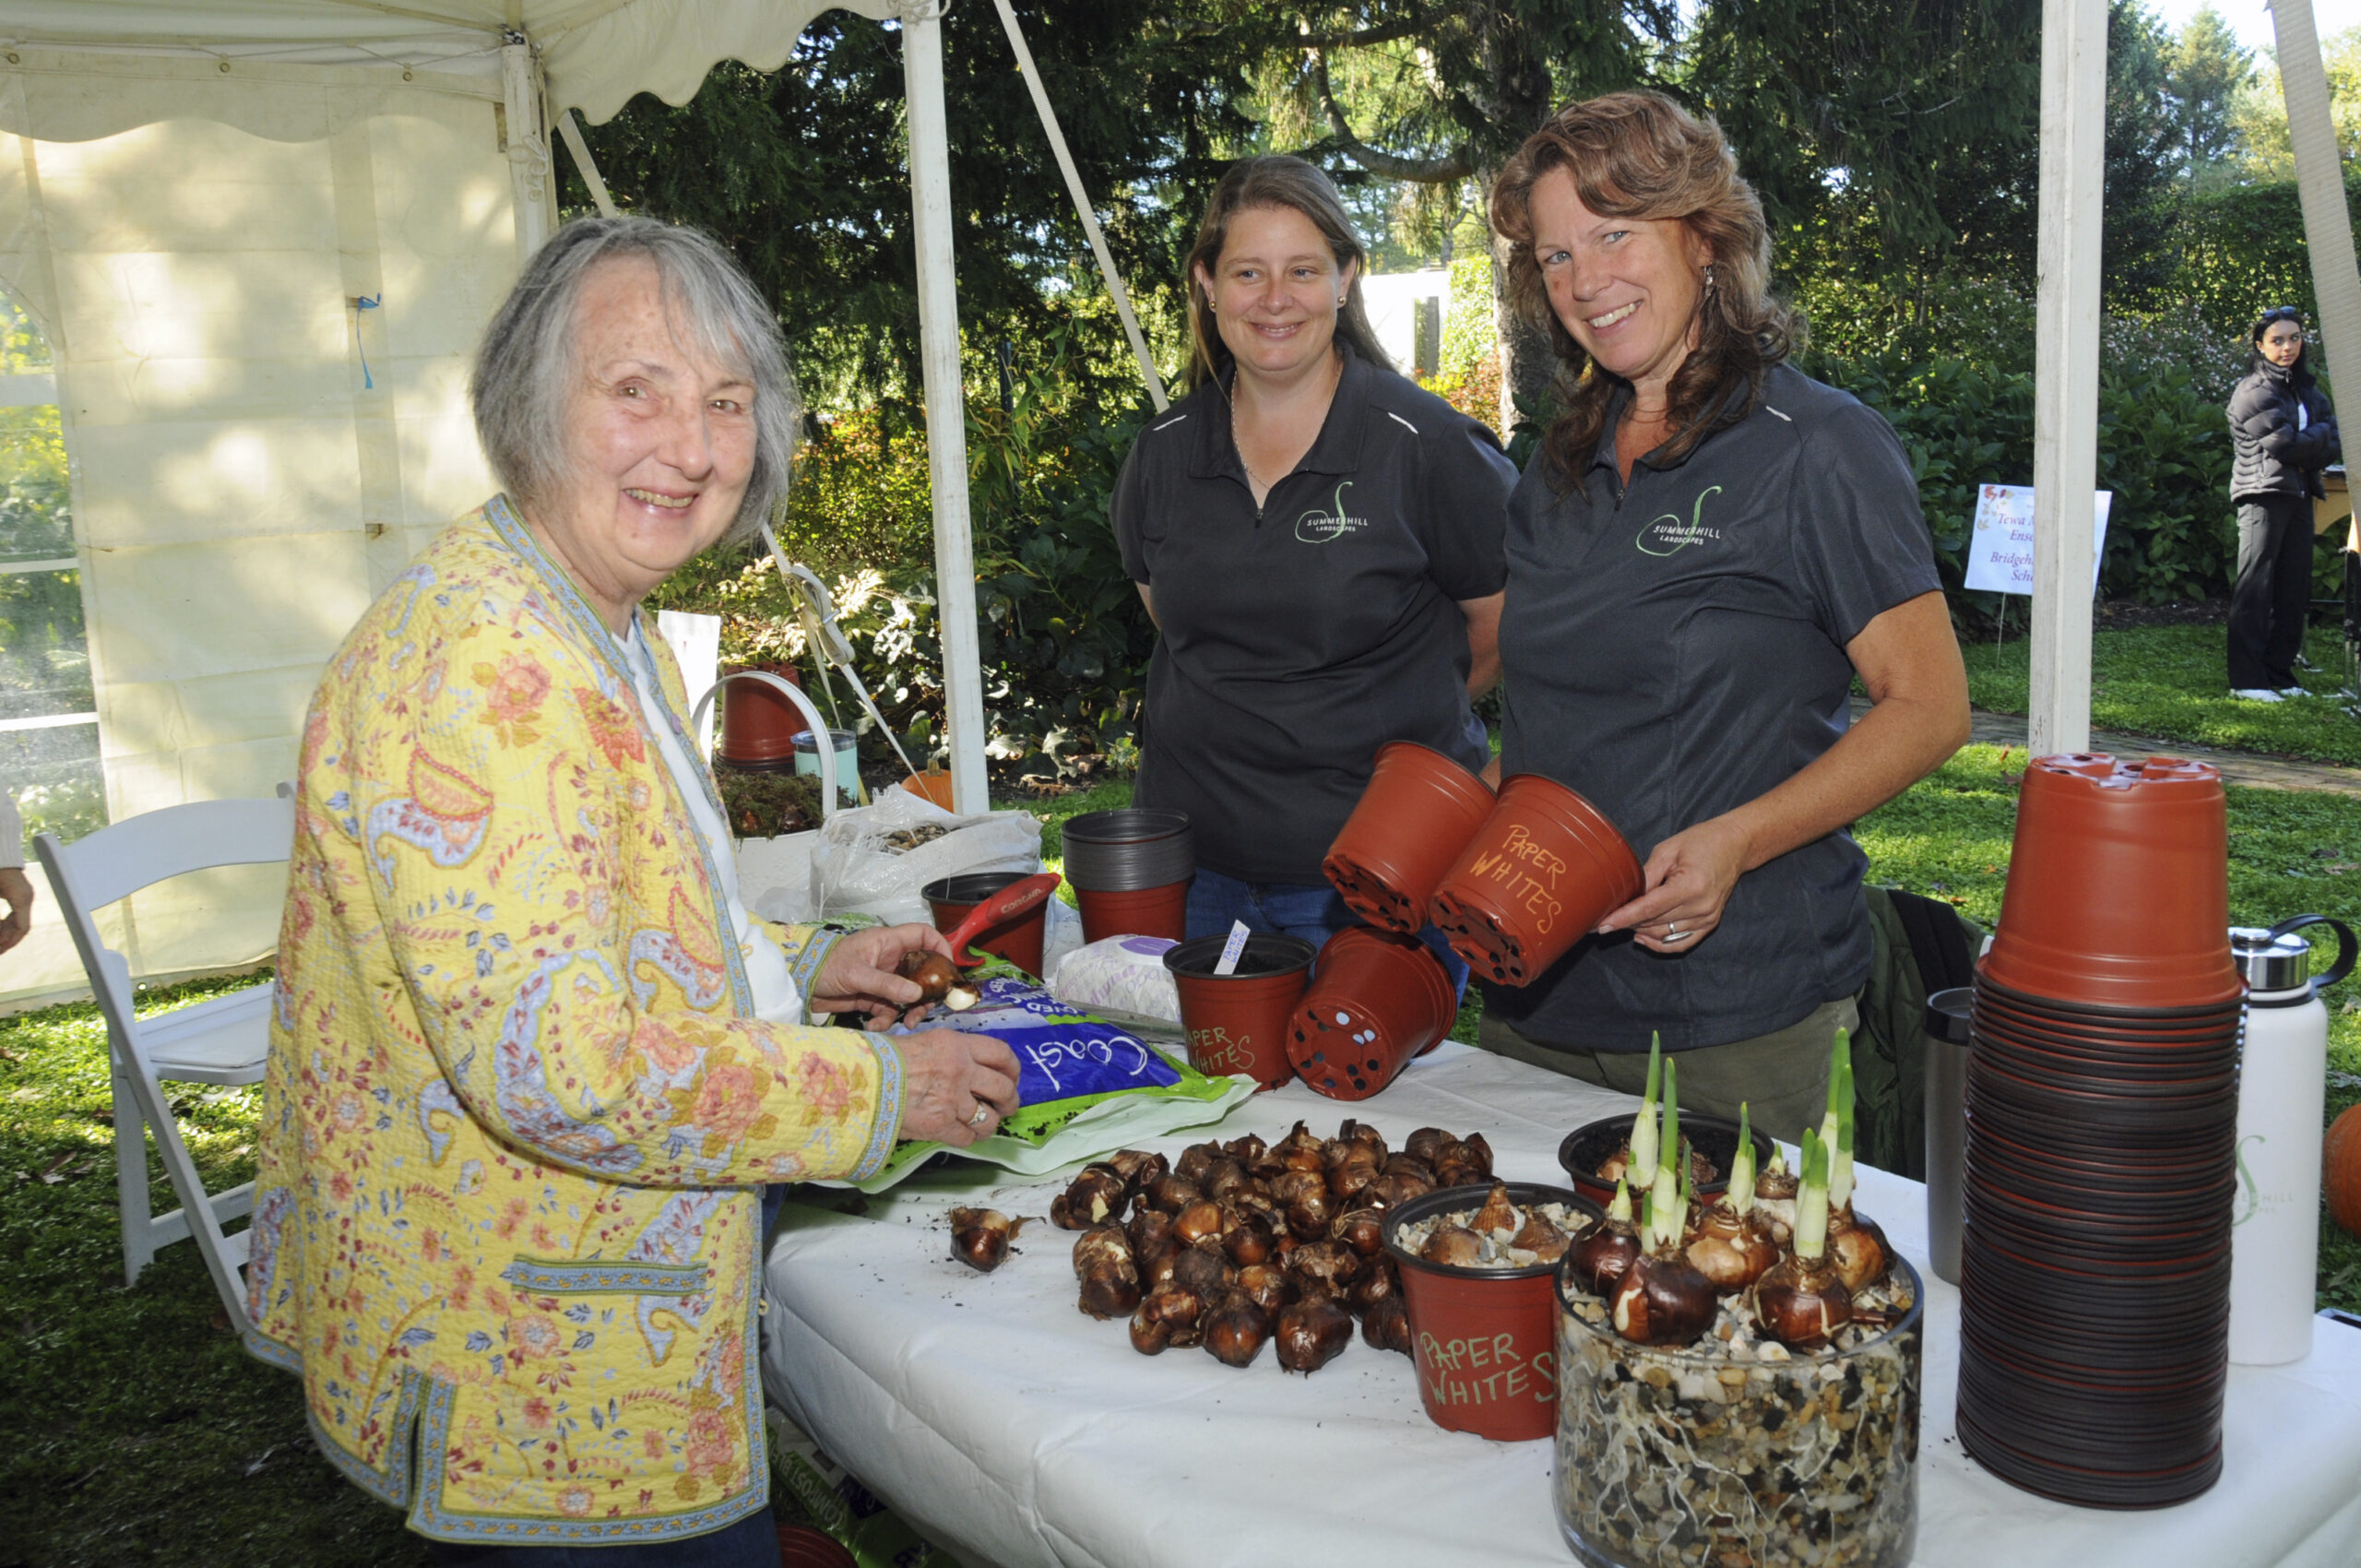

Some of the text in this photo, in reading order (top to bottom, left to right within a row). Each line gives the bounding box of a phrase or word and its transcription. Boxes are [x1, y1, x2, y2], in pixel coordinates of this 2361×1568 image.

[1307, 517, 1368, 527] SUMMERHILL
[1653, 525, 1721, 540] SUMMERHILL
[1999, 513, 2025, 526] Tewa
[1659, 535, 1705, 546] LANDSCAPES
[1990, 552, 2035, 567] Bridgeh
[1502, 824, 1567, 890] PAPER
[1469, 849, 1562, 934] WHITES
[1026, 1035, 1149, 1092] Coast
[1420, 1331, 1521, 1371] PAPER
[1427, 1351, 1555, 1406] WHITES
